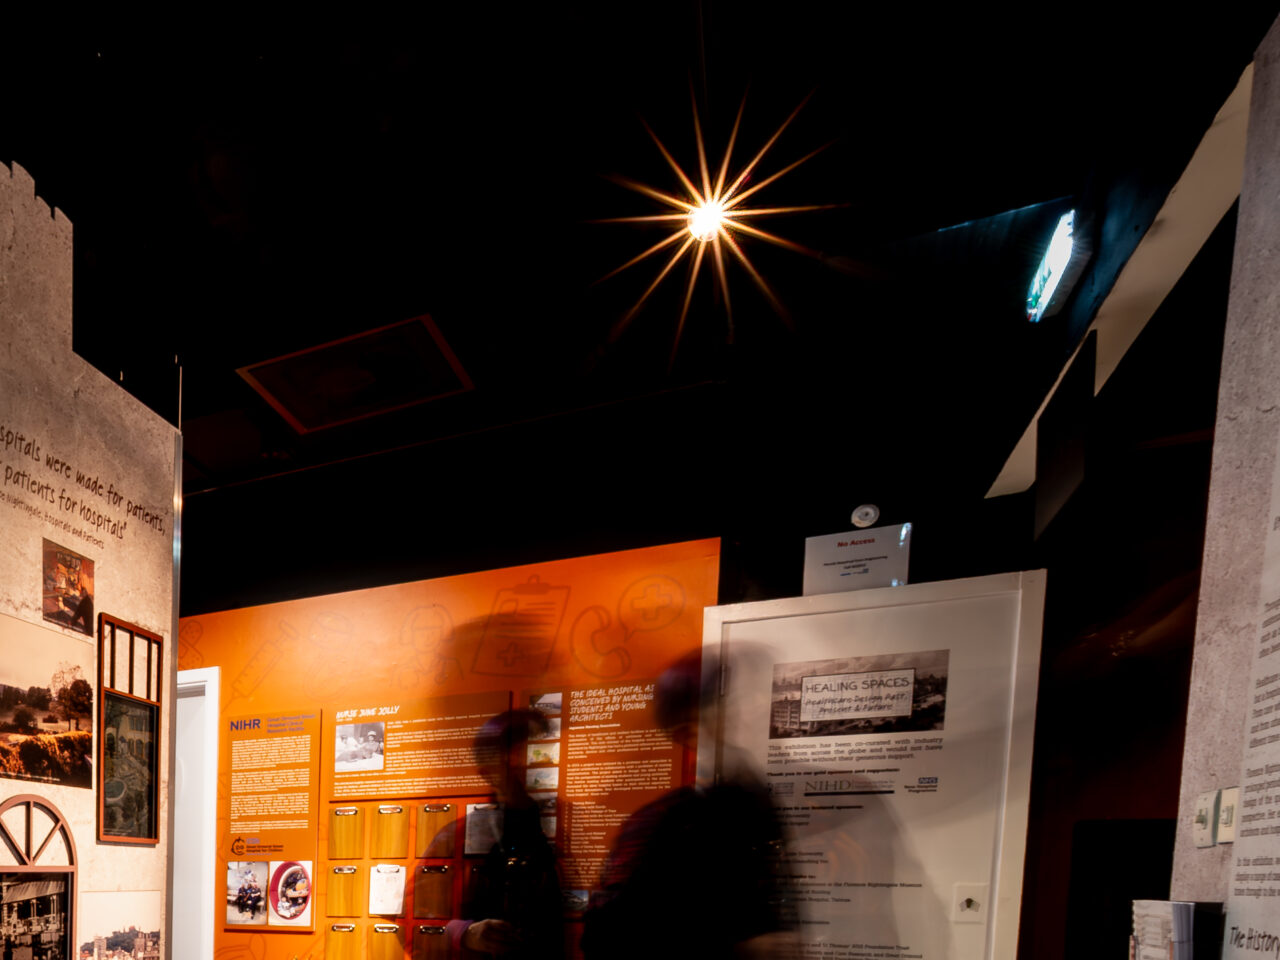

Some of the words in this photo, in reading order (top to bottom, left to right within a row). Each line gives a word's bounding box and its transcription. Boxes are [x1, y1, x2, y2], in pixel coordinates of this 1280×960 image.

[5, 466, 55, 503] patients
[59, 491, 78, 511] for
[46, 454, 71, 478] were
[76, 470, 103, 496] made
[108, 484, 123, 505] for
[127, 500, 166, 536] patients,
[72, 524, 83, 537] and
[850, 538, 875, 546] Access
[586, 688, 606, 696] IDEAL
[608, 685, 643, 695] HOSPITAL
[806, 682, 857, 693] HEALING
[862, 677, 910, 689] SPACES
[570, 696, 610, 706] CONCEIVED
[612, 695, 622, 703] BY
[570, 705, 603, 714] STUDENTS
[622, 702, 646, 711] YOUNG
[230, 719, 260, 731] NIHR
[914, 737, 943, 745] industry
[805, 780, 851, 791] NIHD
[1229, 926, 1244, 948] The
